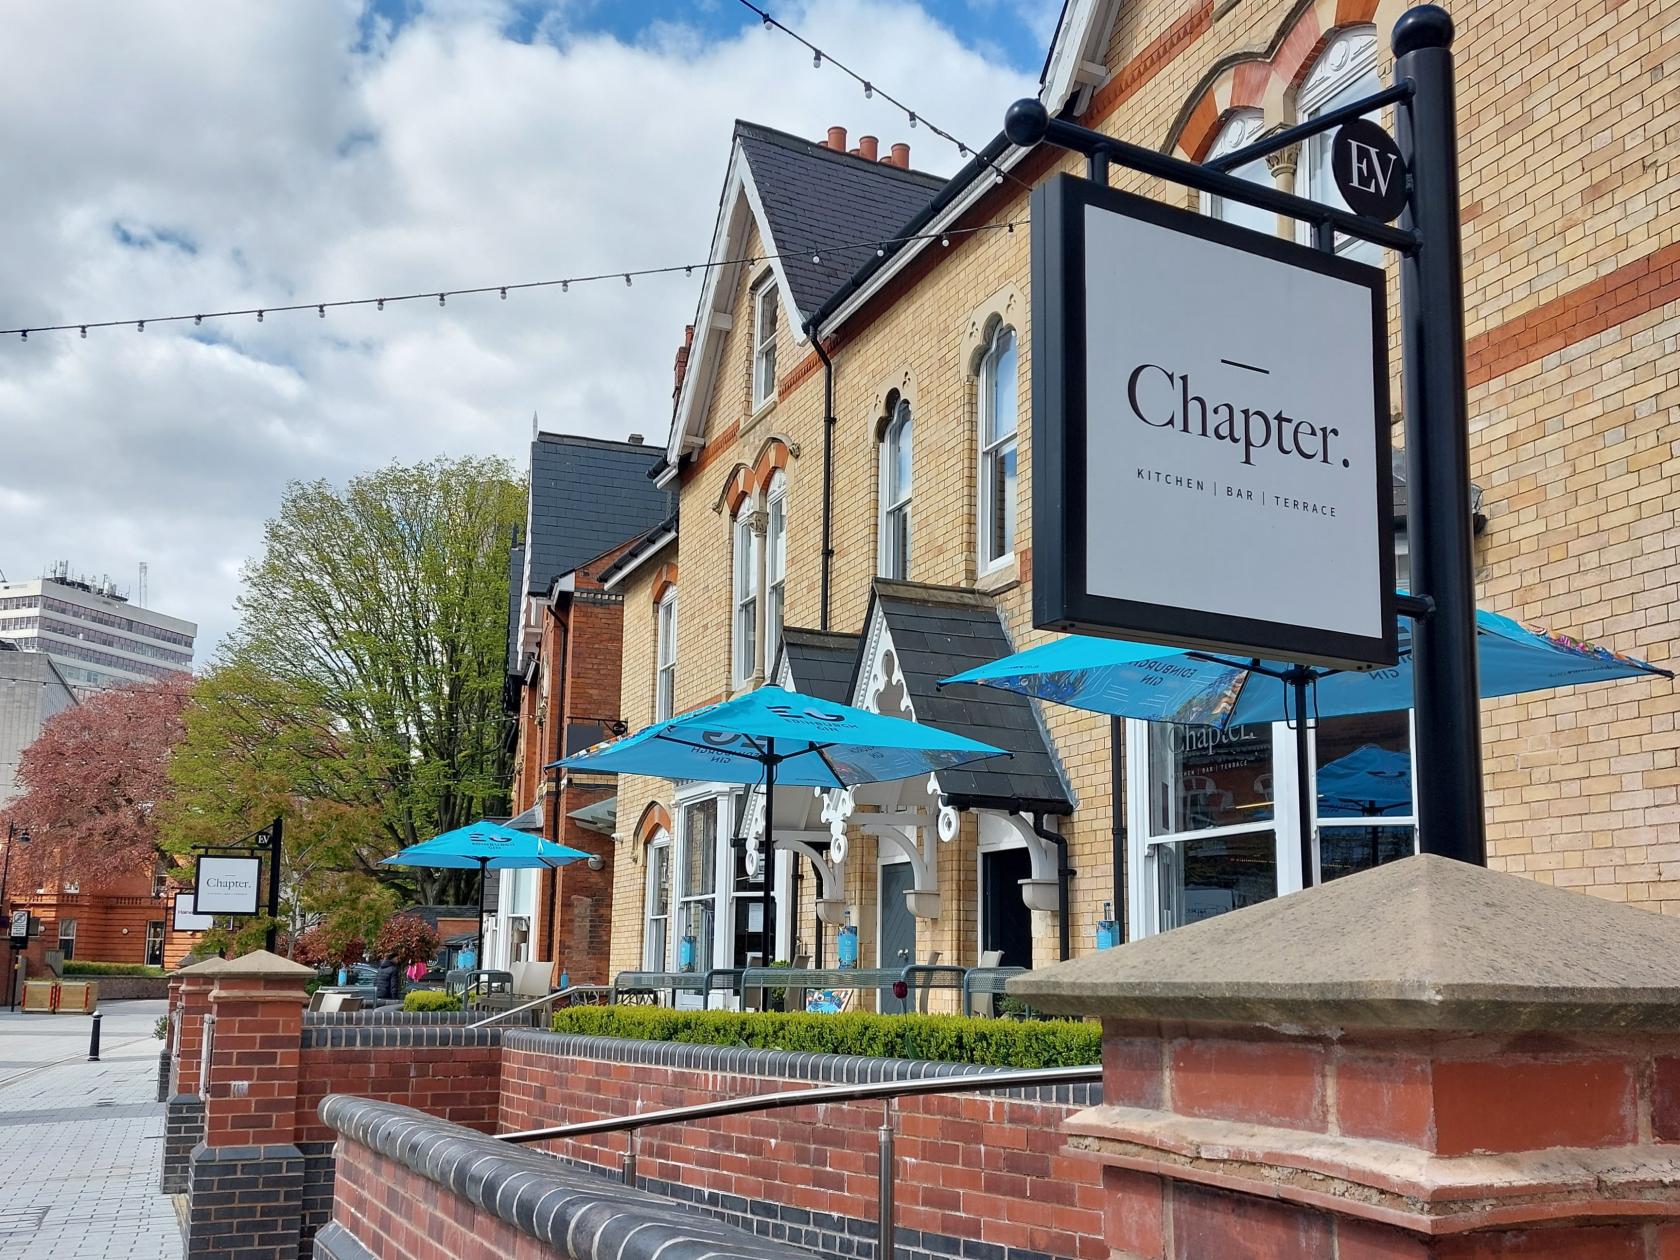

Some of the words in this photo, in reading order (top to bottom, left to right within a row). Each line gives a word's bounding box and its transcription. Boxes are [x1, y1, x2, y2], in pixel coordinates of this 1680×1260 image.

[1347, 138, 1398, 197] EV
[1127, 363, 1350, 468] Chapter.
[1137, 468, 1204, 491] KITCHEN
[1226, 486, 1253, 501] BAR
[1274, 495, 1336, 517] TERRACE
[258, 835, 270, 844] EV
[206, 877, 252, 891] Chapter.
